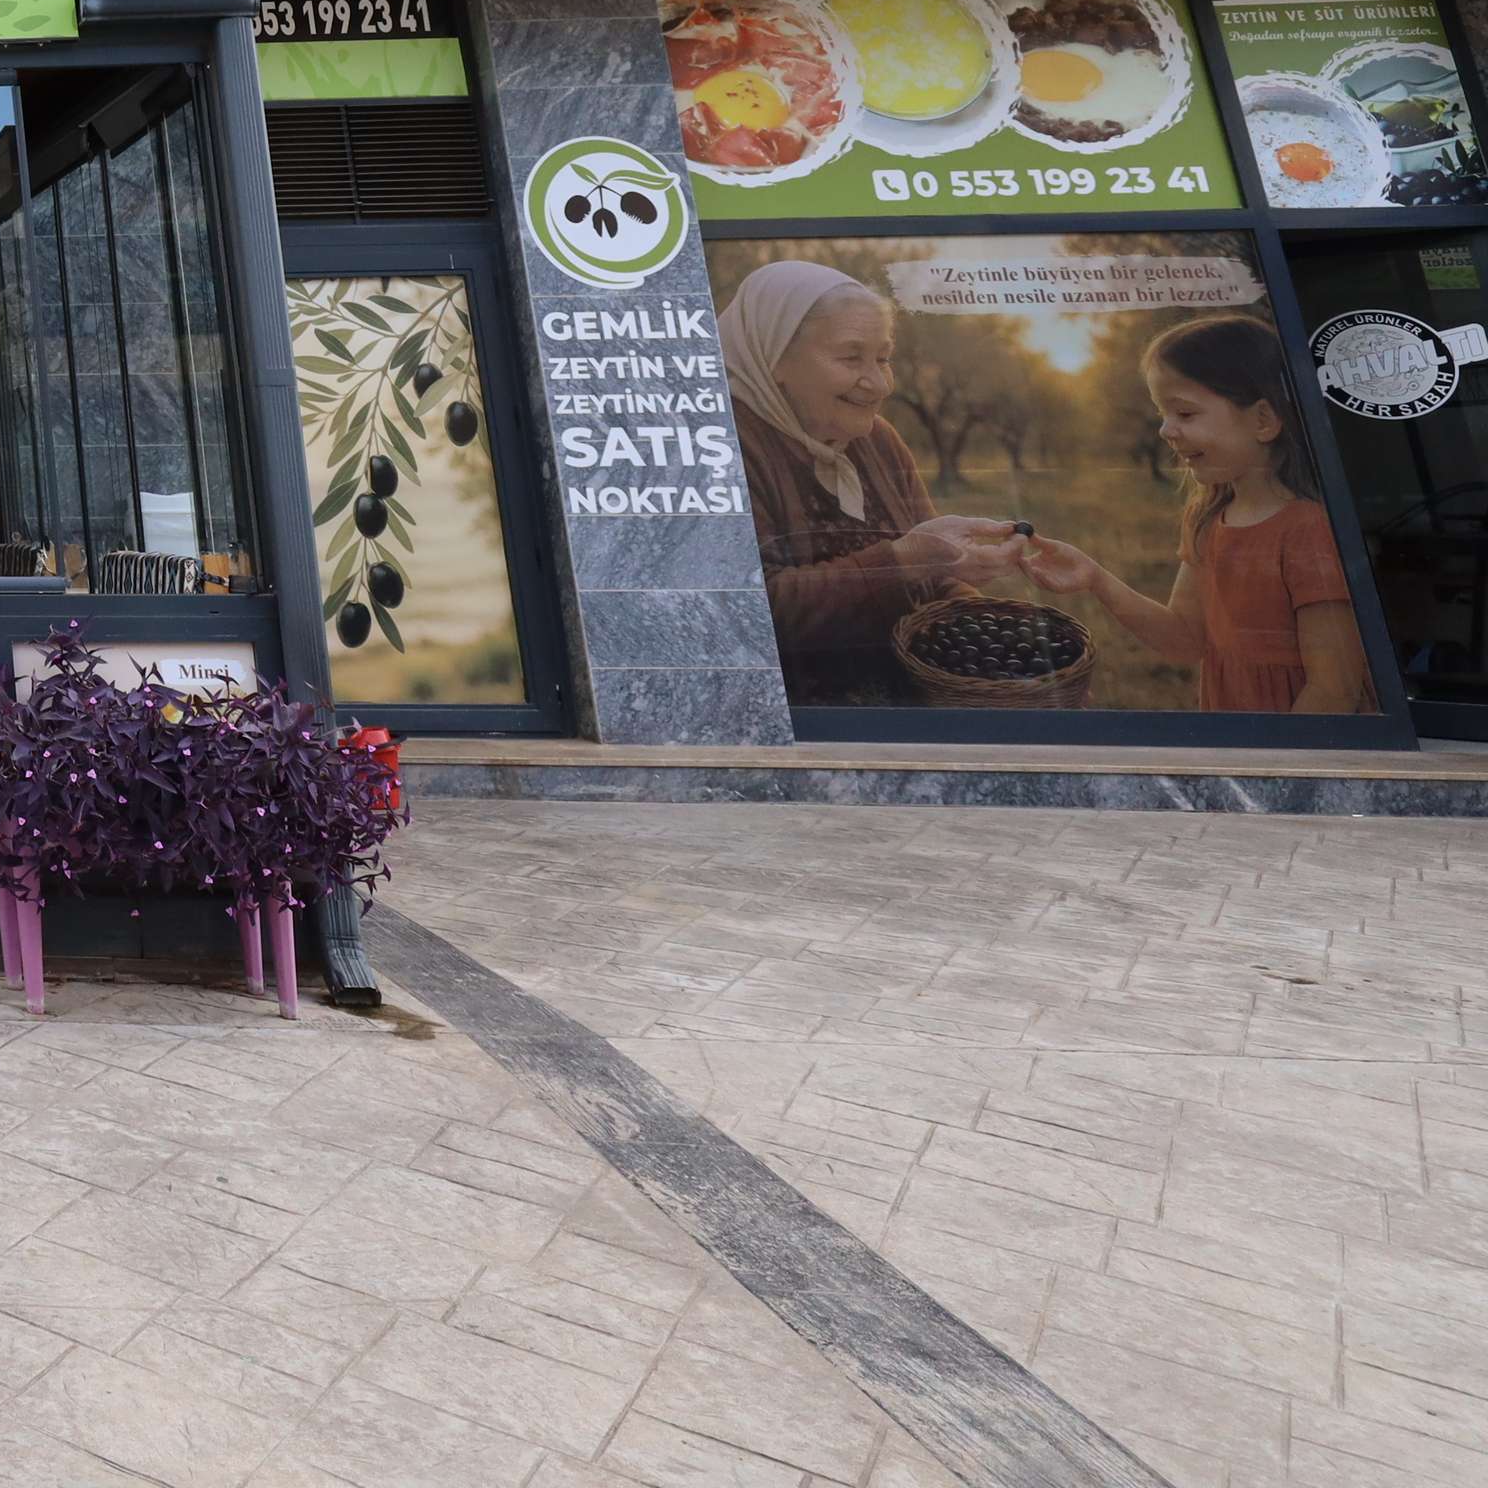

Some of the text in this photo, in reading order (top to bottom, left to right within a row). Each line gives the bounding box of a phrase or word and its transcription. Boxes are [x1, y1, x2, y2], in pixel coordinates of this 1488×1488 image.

[302, 0, 351, 35] 199
[1222, 2, 1436, 25] ZEYTİN VE SÜT ÜRÜNLERİ
[912, 166, 1210, 198] 0 553 199 23 41
[930, 266, 1018, 286] "Zeytinle
[1024, 265, 1105, 285] büyüyen
[1111, 265, 1138, 280] bir
[922, 289, 998, 305] nesilden
[1004, 288, 1057, 304] nesile
[1062, 289, 1133, 303] uzanan
[1136, 287, 1164, 302] bir
[542, 300, 712, 341] GEMLİK
[1314, 313, 1423, 358] NATUREL ÜRÜNLER
[548, 350, 720, 380] ZEYTİN VE
[1317, 328, 1487, 388] AHVALTI
[554, 388, 725, 414] ZEYTİNYAĞI
[1345, 371, 1454, 417] HER SABAH
[561, 426, 734, 478] SATIŞ
[568, 486, 745, 513] NOKTASI
